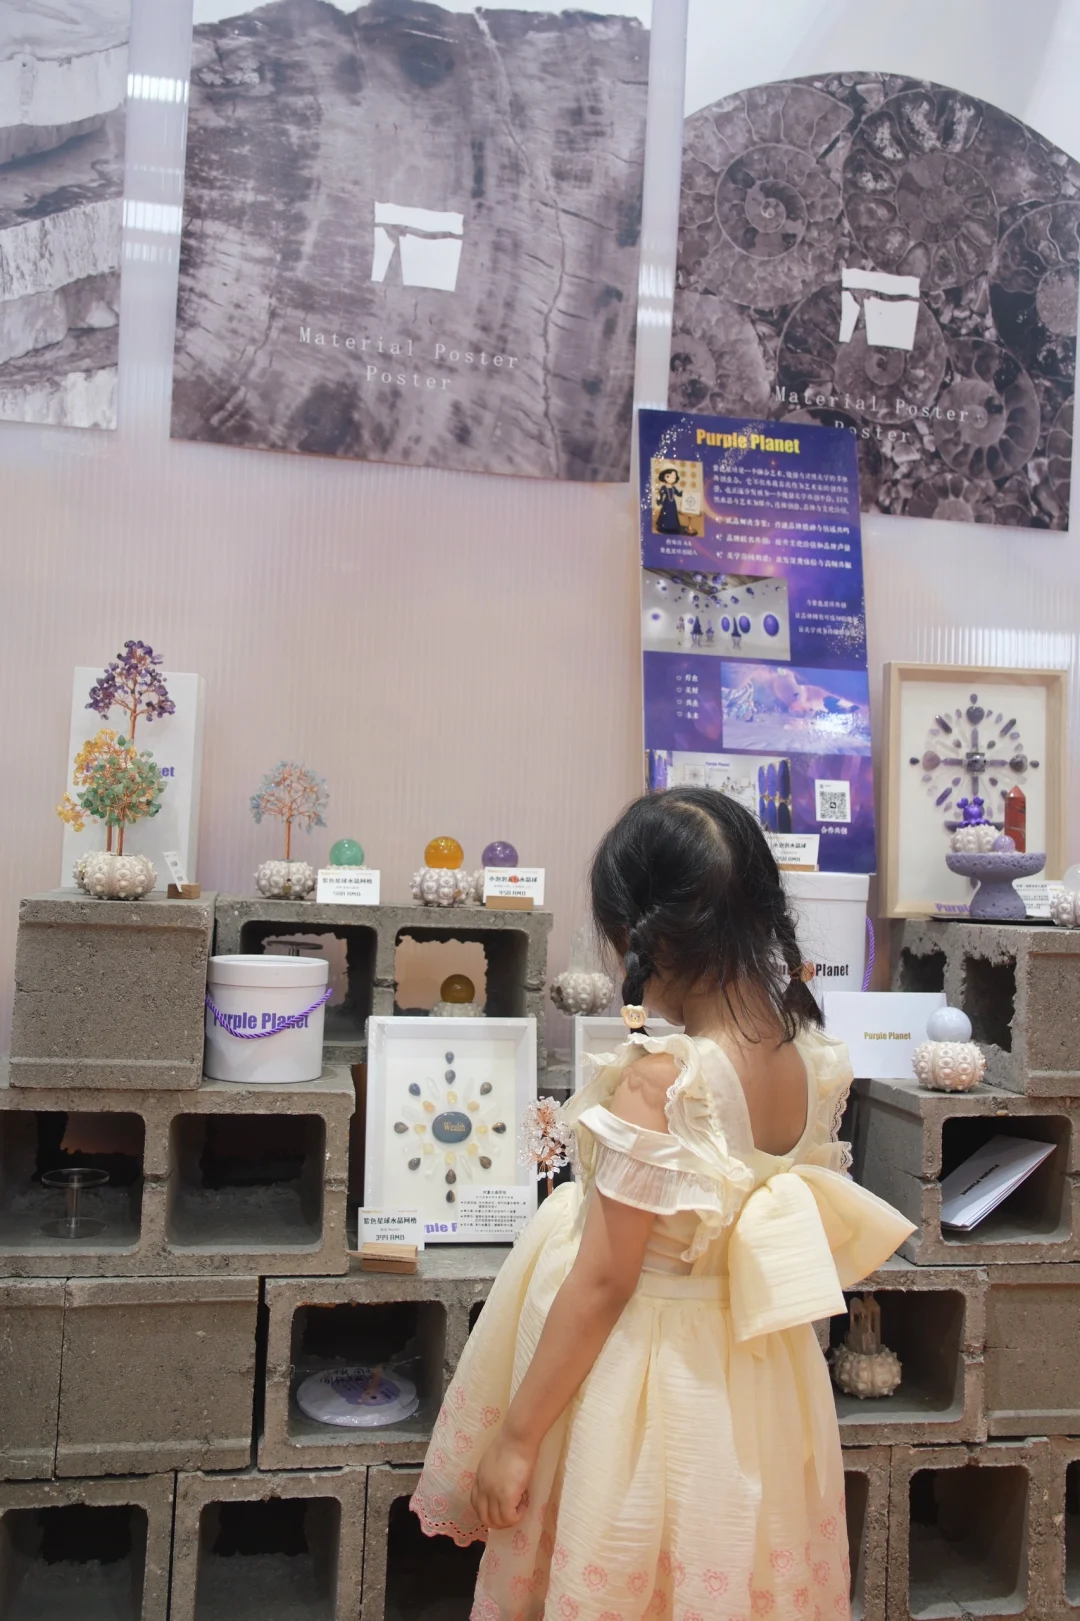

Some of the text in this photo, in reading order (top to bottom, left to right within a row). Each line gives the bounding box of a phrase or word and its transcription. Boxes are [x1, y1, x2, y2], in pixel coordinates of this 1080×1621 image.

[299, 327, 519, 369] Material Poster
[366, 365, 451, 391] Poster
[775, 385, 969, 422] Material Poster
[696, 428, 800, 454] Purple Planet
[935, 902, 971, 913] Purpl
[815, 963, 849, 977] Planet
[864, 1031, 911, 1040] Purple Planet
[363, 1217, 417, 1225] 紫色星球水晶网格
